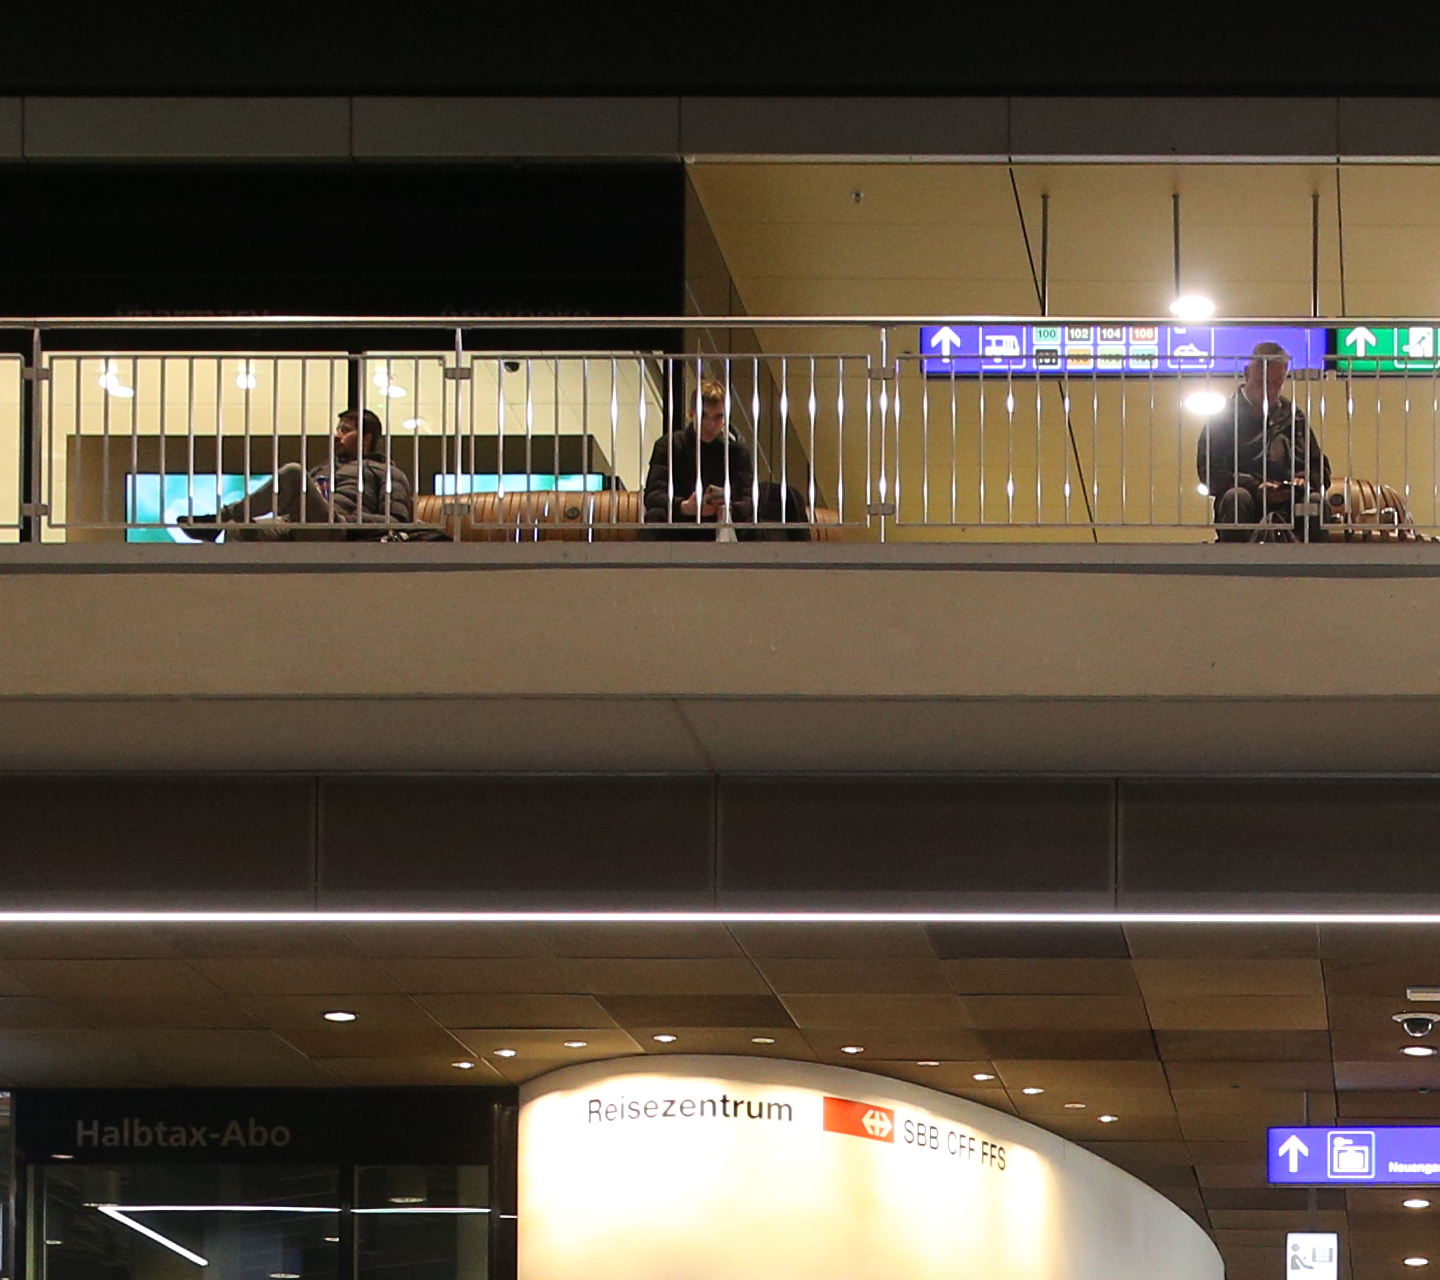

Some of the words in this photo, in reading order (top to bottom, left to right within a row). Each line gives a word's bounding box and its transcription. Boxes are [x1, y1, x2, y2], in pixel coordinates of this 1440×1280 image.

[1037, 328, 1057, 339] 100
[1069, 328, 1089, 339] 102
[1101, 328, 1121, 339] 104
[588, 1093, 793, 1124] Reisezentrum
[76, 1118, 291, 1148] Halbtax-Abo
[903, 1120, 940, 1150] SBB
[947, 1130, 976, 1159] CFF
[980, 1139, 1007, 1171] FFS
